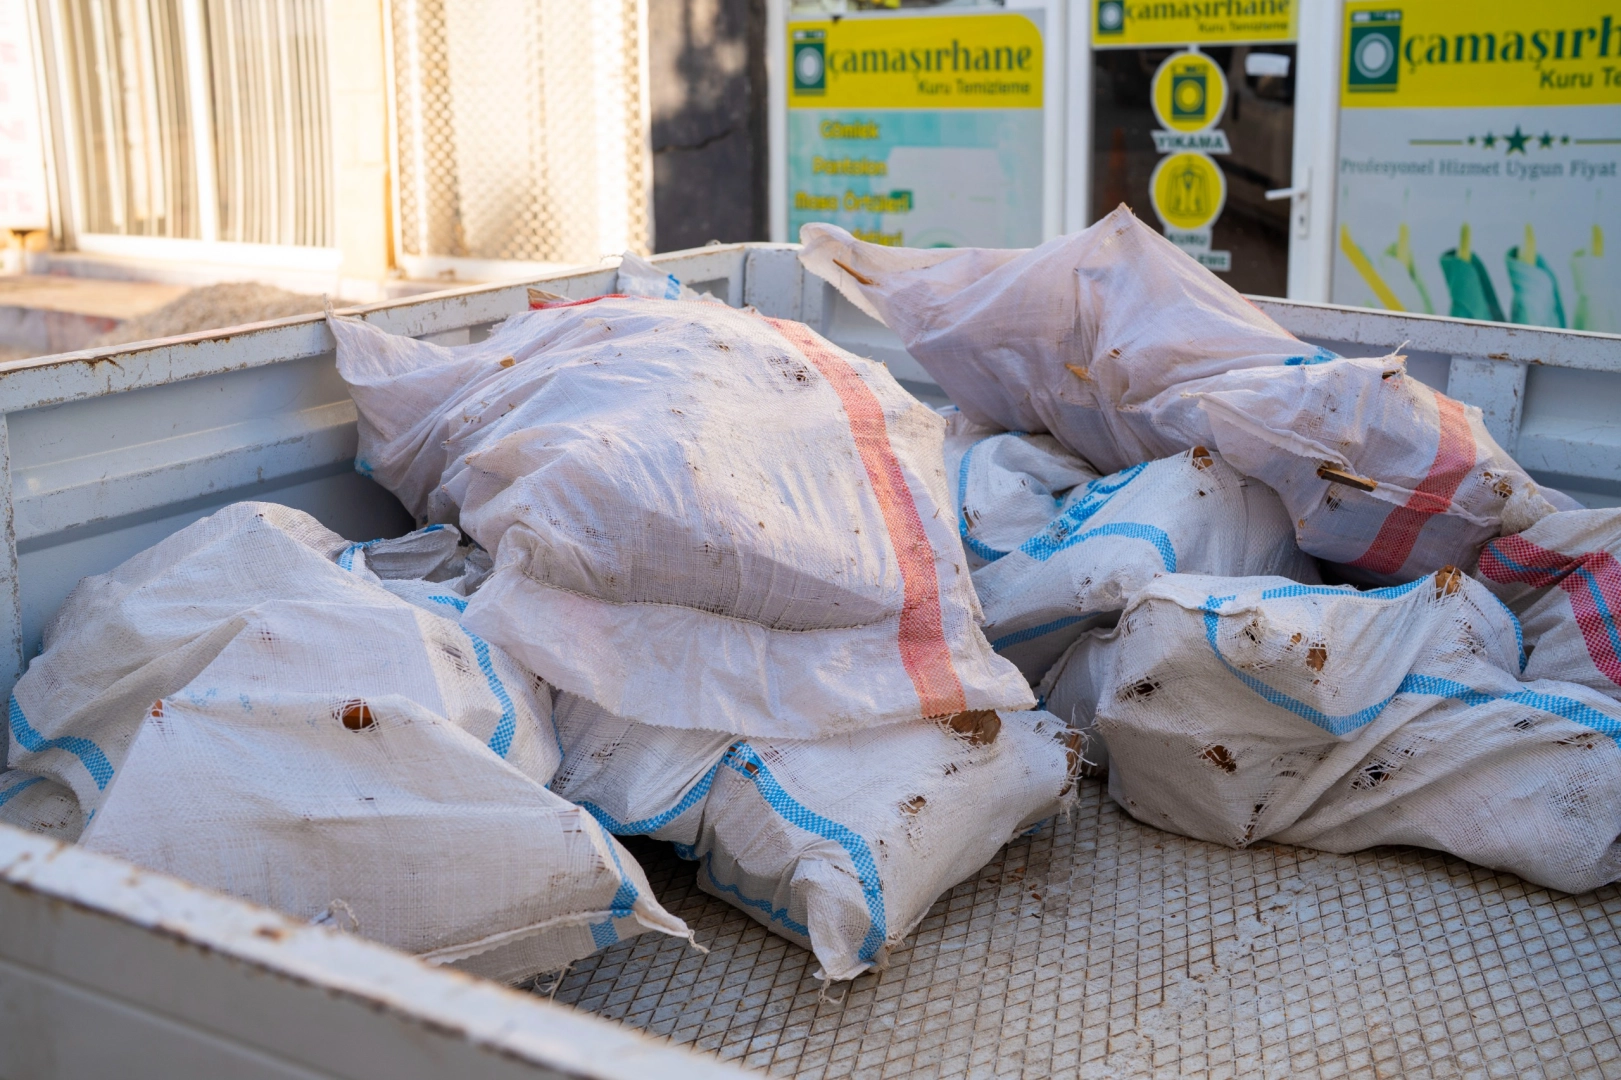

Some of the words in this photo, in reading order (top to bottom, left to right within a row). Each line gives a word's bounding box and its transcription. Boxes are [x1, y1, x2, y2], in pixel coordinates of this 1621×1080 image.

[829, 39, 1032, 82] çamaşırhane
[917, 80, 951, 96] Kuru
[957, 79, 1031, 96] Temizleme
[1540, 70, 1593, 89] Kuru
[1158, 134, 1225, 148] YIKAMA
[1340, 156, 1435, 178] Profesyonel
[1439, 158, 1500, 176] Hizmet
[1506, 159, 1564, 181] Uygun
[1570, 159, 1617, 181] Fiyat
